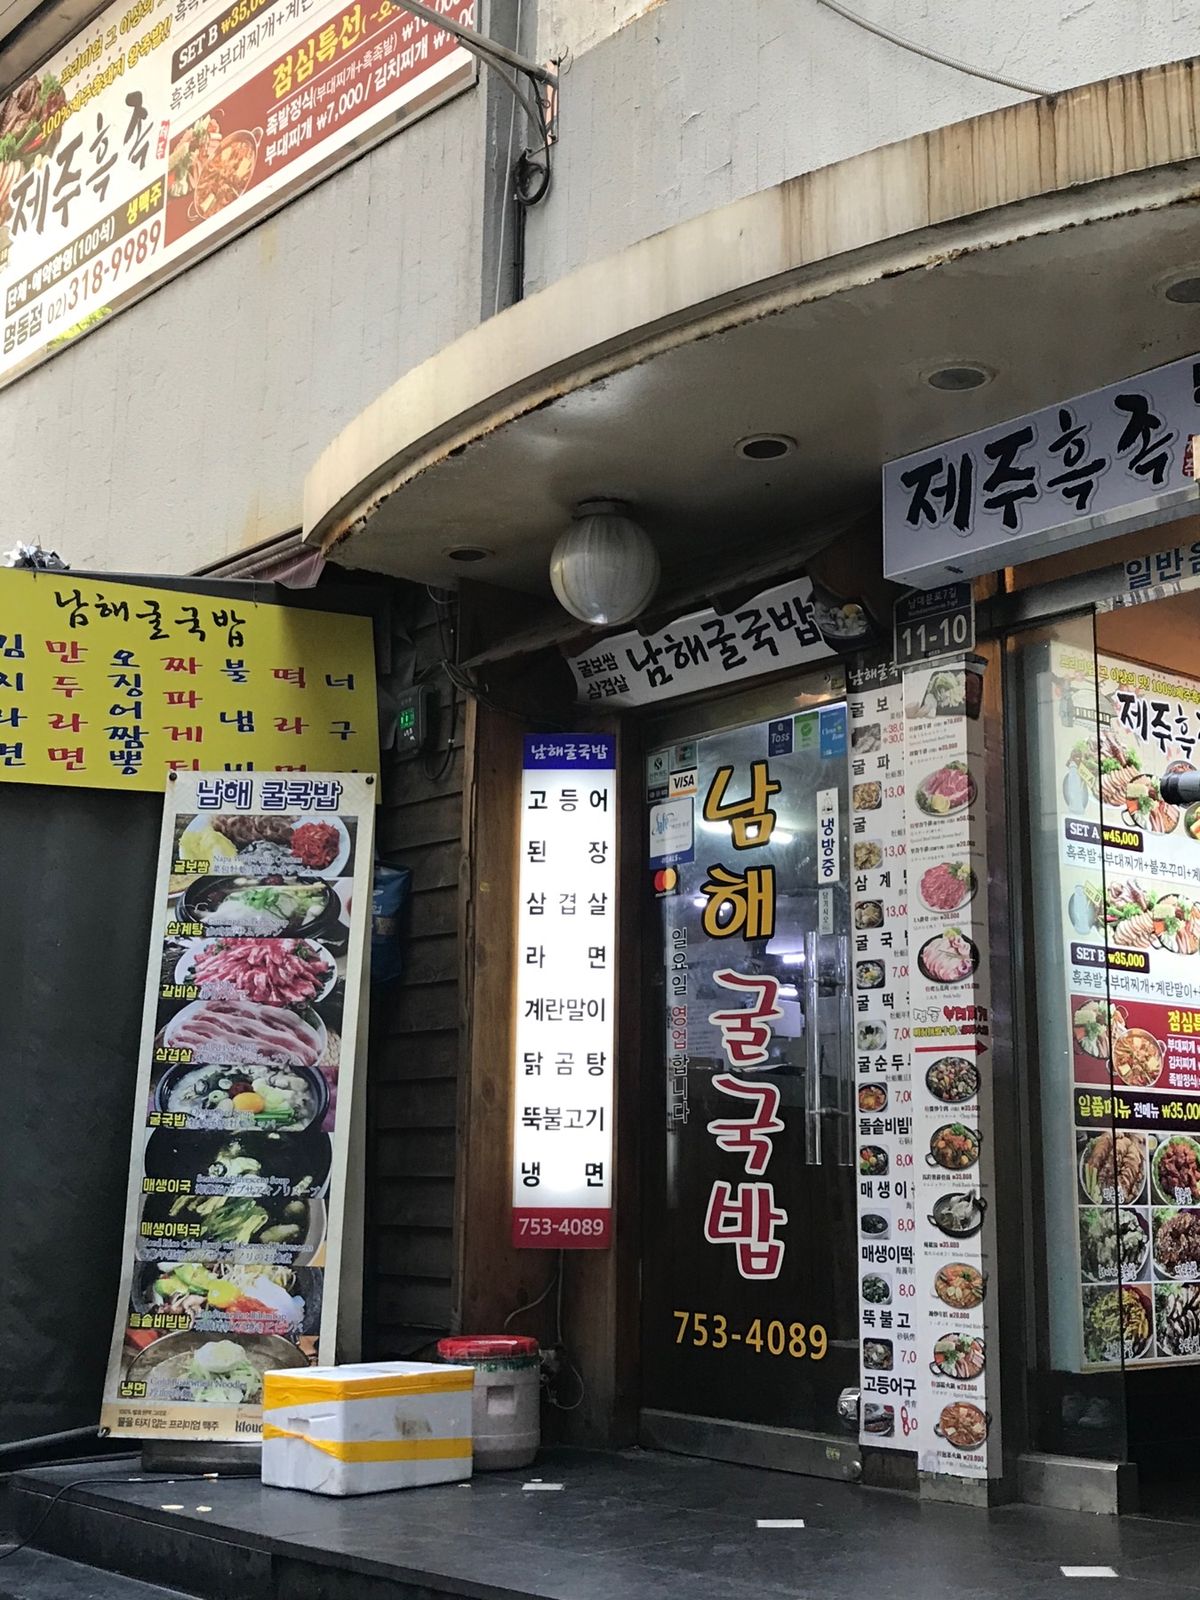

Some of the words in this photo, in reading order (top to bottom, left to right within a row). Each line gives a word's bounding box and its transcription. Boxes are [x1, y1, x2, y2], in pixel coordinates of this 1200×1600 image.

[178, 34, 205, 69] SET
[207, 24, 218, 46] B
[374, 34, 428, 91] 김치찌개
[11, 92, 154, 235] 제주흑족
[127, 182, 162, 225] 생맥주
[4, 303, 43, 355] 명동점
[901, 394, 1174, 532] 제주흑족
[54, 589, 246, 648] 남해굴국밥
[625, 596, 822, 687] 남해굴국밥
[902, 614, 967, 656] 11-10
[576, 653, 620, 679] 굴보쌈
[587, 675, 630, 700] 삼겹살
[1116, 693, 1200, 759] 제주흑
[531, 743, 608, 760] 남해굴국밥
[673, 774, 695, 789] VISA
[197, 780, 252, 810] 남해
[261, 780, 342, 811] 굴국밥
[1070, 822, 1090, 837] SET
[1092, 829, 1100, 840] A
[1102, 830, 1140, 847] ₩45,000
[821, 817, 836, 878] 냉방중
[174, 859, 211, 874] 굴보쌈
[167, 921, 204, 937] 삼계탕
[1076, 947, 1096, 962] SET
[1098, 950, 1105, 962] B
[1108, 952, 1145, 968] ₩35,000
[162, 983, 198, 1000] 갈비살
[524, 998, 605, 1022] 계란말이
[155, 1047, 193, 1062] 삼겹살
[149, 1112, 187, 1127] 굴국밥
[522, 1106, 604, 1131] 뚝불고기
[1162, 1102, 1200, 1121] ₩35,00
[859, 1117, 912, 1135] 돌솥비빔
[143, 1177, 191, 1193] 매생이국
[140, 1221, 201, 1238] 매생이떡국
[519, 1218, 604, 1236] 753-4089
[862, 1244, 915, 1264] 매생이떡
[129, 1312, 193, 1331] 돌솥비빔밥
[673, 1310, 828, 1360] 753-4089
[121, 1381, 147, 1398] 냉면
[863, 1376, 916, 1397] 고등어구
[152, 1418, 167, 1430] 않는
[169, 1419, 201, 1431] 프리미엄
